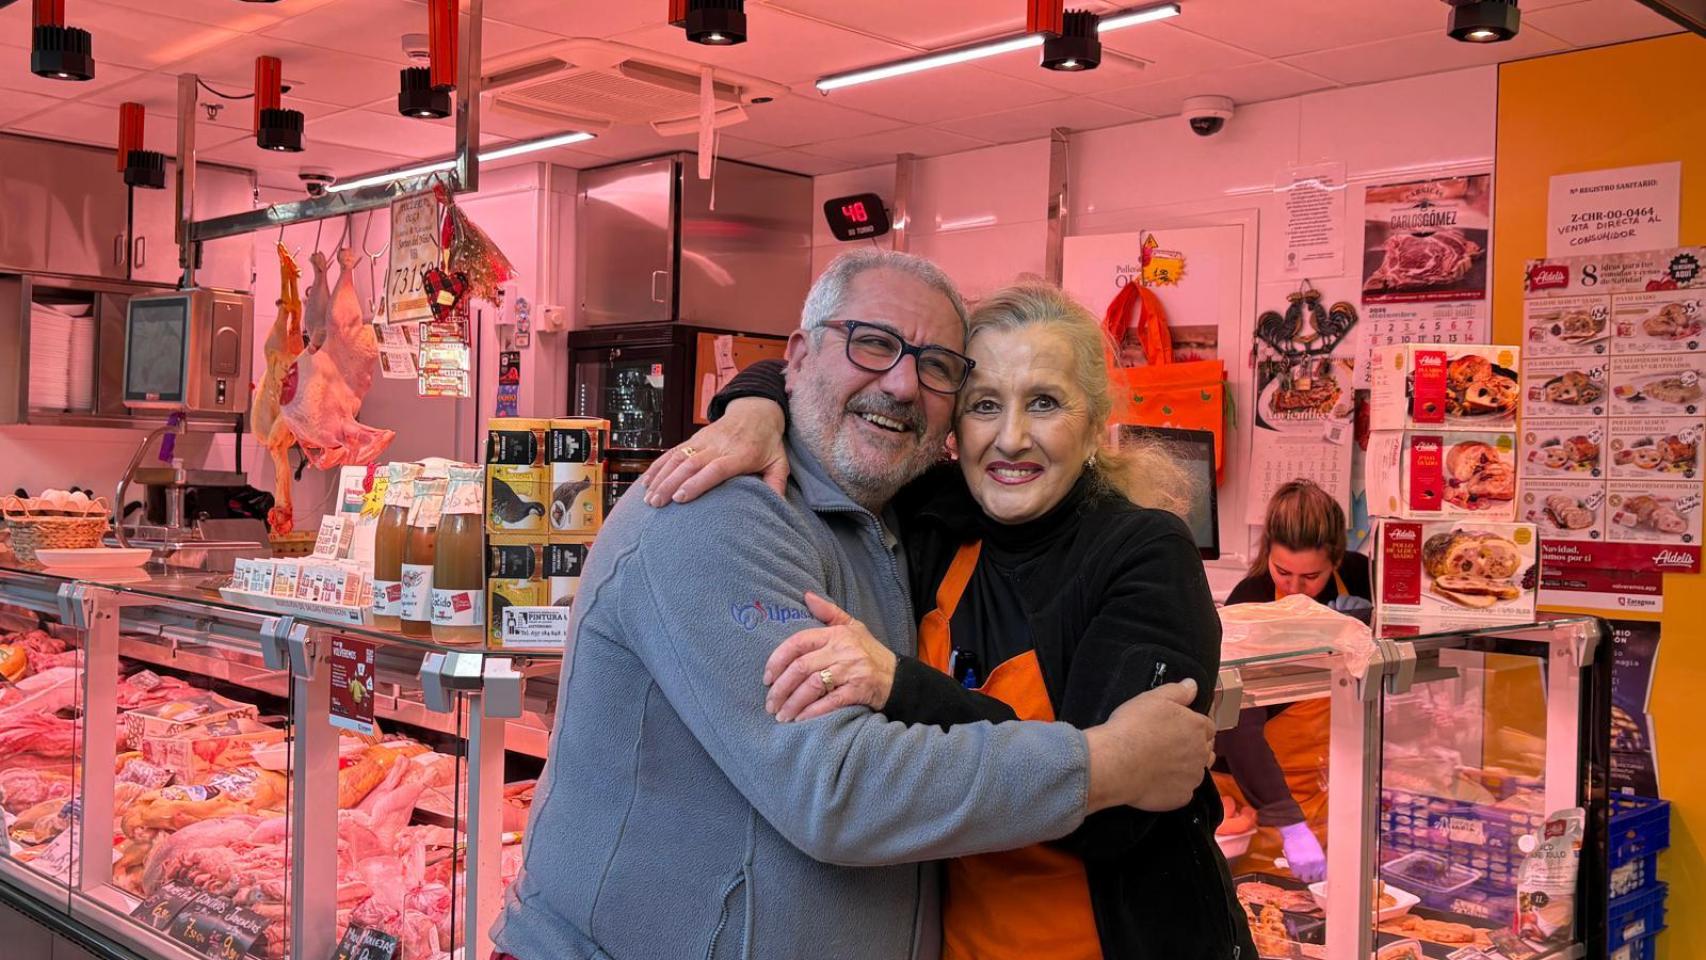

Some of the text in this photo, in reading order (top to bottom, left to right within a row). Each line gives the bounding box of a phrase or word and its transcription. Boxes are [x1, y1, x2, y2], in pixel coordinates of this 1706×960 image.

[1579, 183, 1614, 194] REGISTRO
[841, 202, 868, 222] 48
[1571, 206, 1654, 223] Z-CHR-00-0464
[1557, 215, 1662, 235] VENTA DIRECTA AL
[1569, 229, 1636, 246] CONSUMIDOR
[1581, 264, 1598, 287] 8
[1401, 336, 1411, 344] 10
[1432, 335, 1442, 344] 12
[1448, 334, 1458, 343] 13
[1464, 334, 1474, 342] 14
[1567, 554, 1583, 562] por
[1584, 554, 1592, 562] ti
